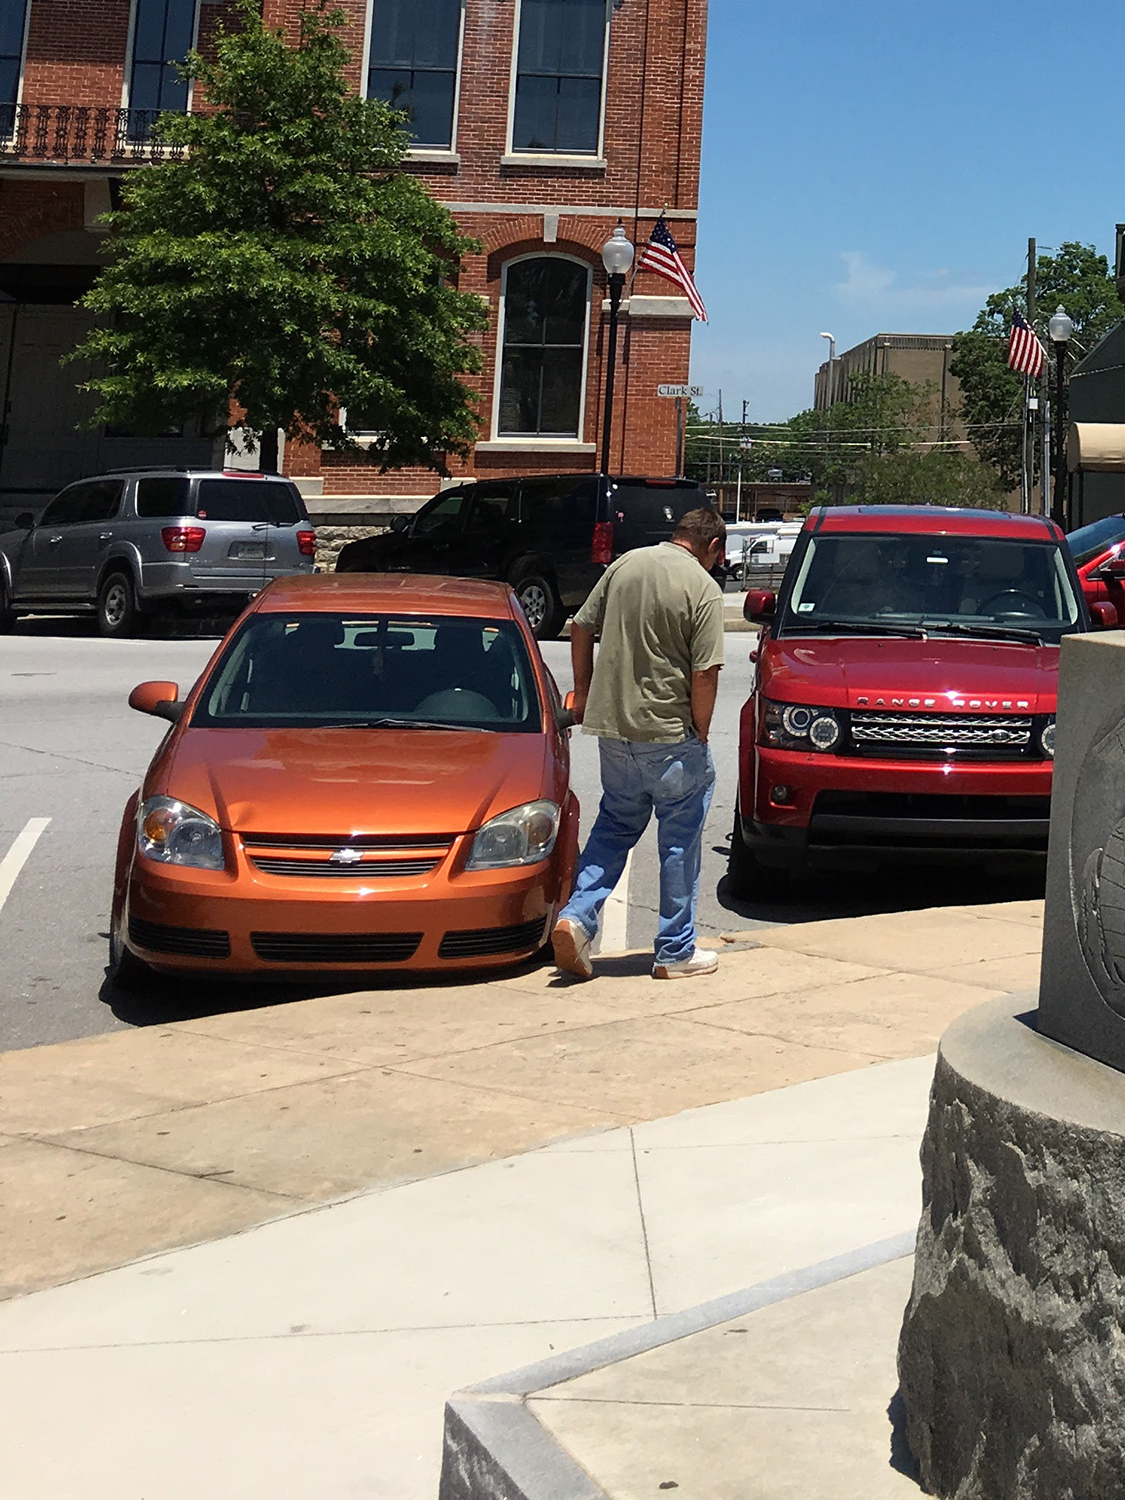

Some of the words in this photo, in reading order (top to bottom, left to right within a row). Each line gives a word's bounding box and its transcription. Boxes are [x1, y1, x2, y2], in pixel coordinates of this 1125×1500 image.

[658, 386, 687, 395] Clark
[690, 386, 703, 396] St.
[857, 696, 936, 708] RANGE
[952, 699, 1029, 709] ROVER
